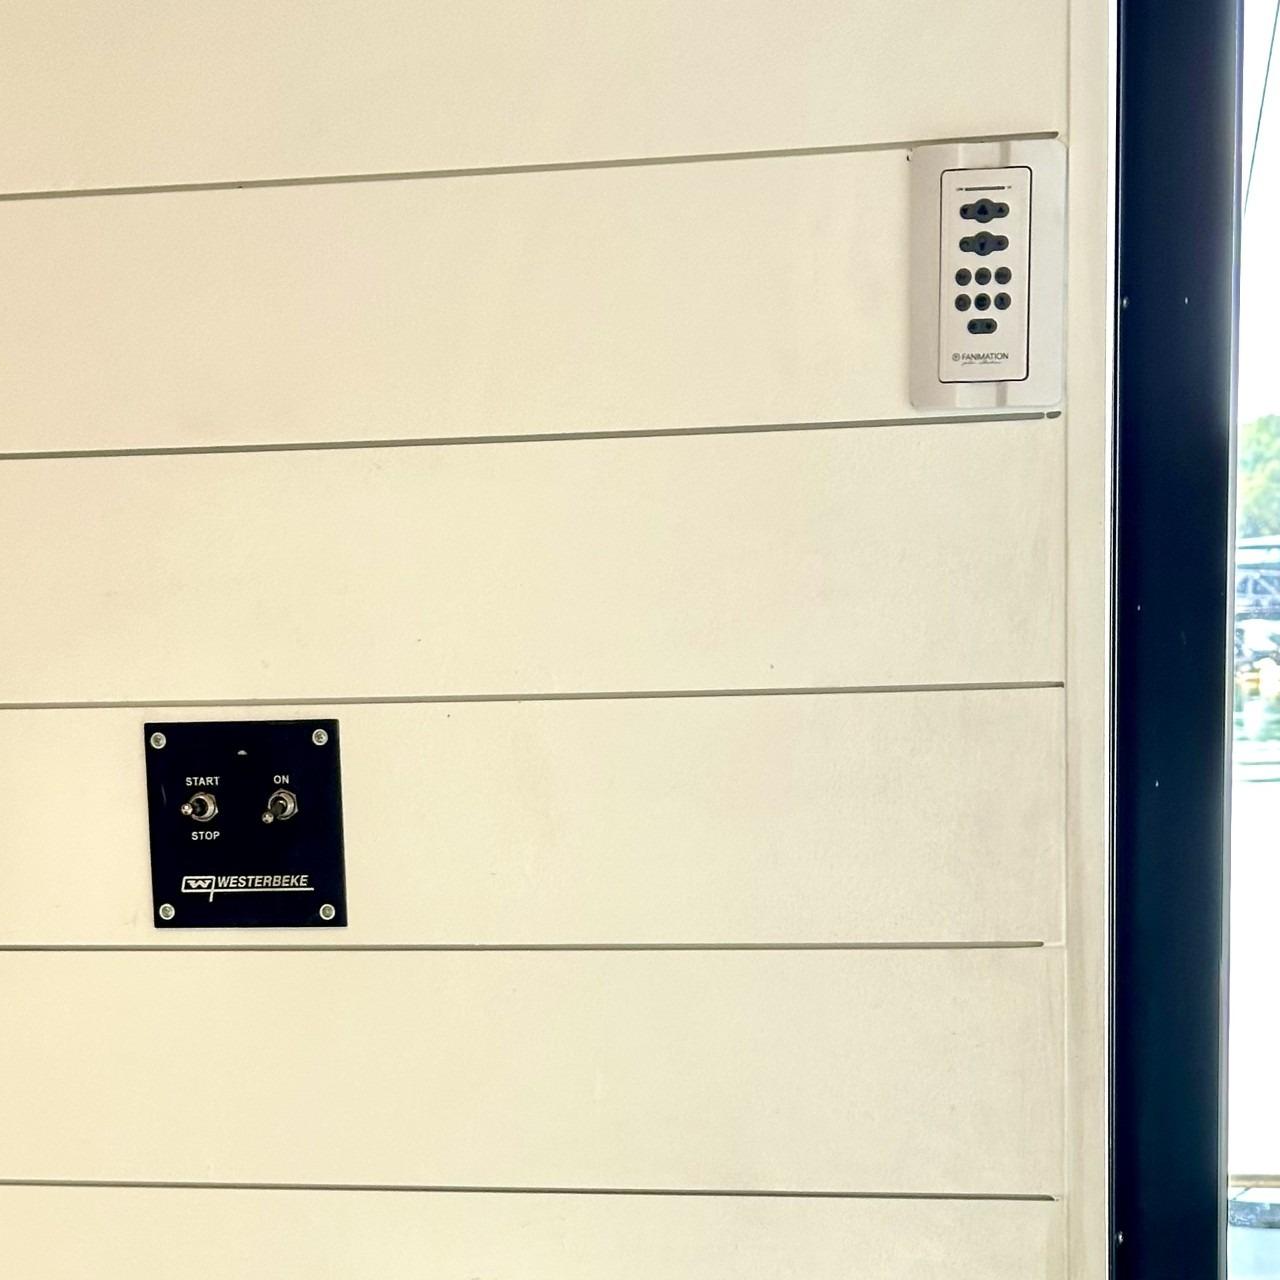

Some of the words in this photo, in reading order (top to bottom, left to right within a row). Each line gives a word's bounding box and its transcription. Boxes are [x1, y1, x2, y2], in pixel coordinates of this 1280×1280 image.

[185, 776, 220, 787] START
[273, 775, 290, 785] ON
[191, 831, 220, 841] STOP
[217, 875, 310, 888] WESTERBEKE
